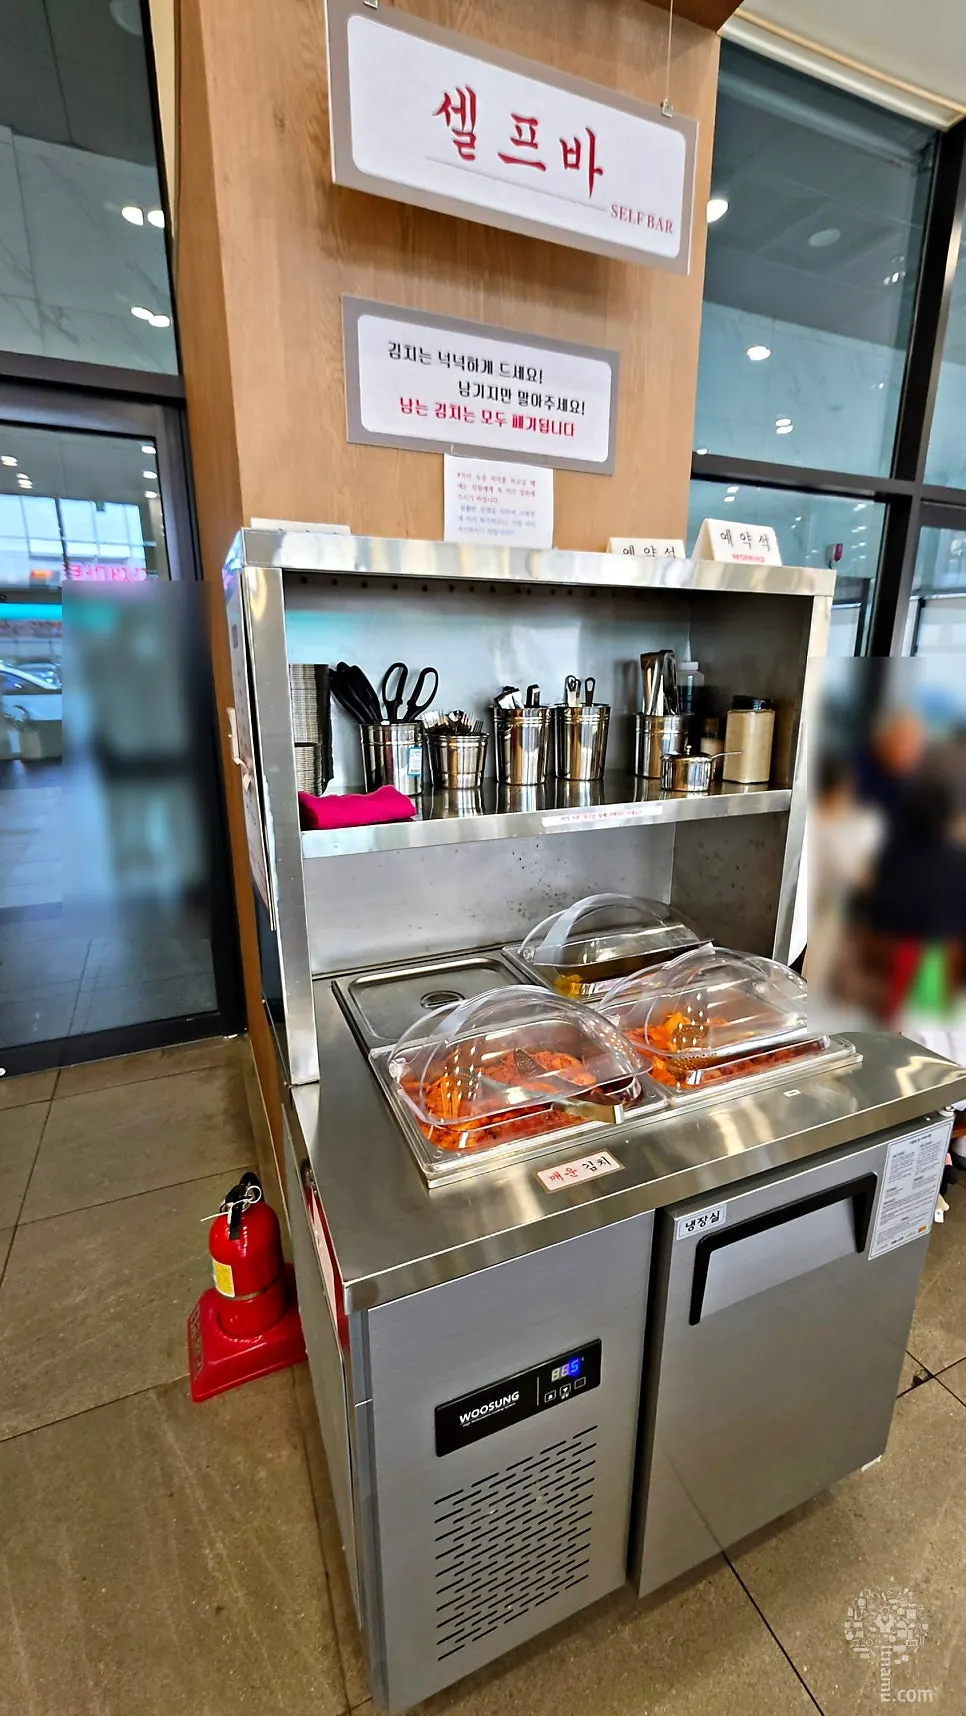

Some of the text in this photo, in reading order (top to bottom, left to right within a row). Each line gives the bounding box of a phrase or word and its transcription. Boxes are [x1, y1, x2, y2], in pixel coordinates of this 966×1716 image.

[611, 204, 673, 235] SELF BAR
[388, 340, 543, 384] 김치는 넉넉하게 드세요!
[400, 396, 428, 417] 남는
[434, 401, 475, 424] 김치는
[480, 409, 507, 428] 모두
[458, 380, 585, 415] 남기지만 말아주세요!
[582, 1156, 612, 1172] 김치
[685, 1210, 720, 1231] 냉장실
[459, 1391, 520, 1424] WOOSUNG
